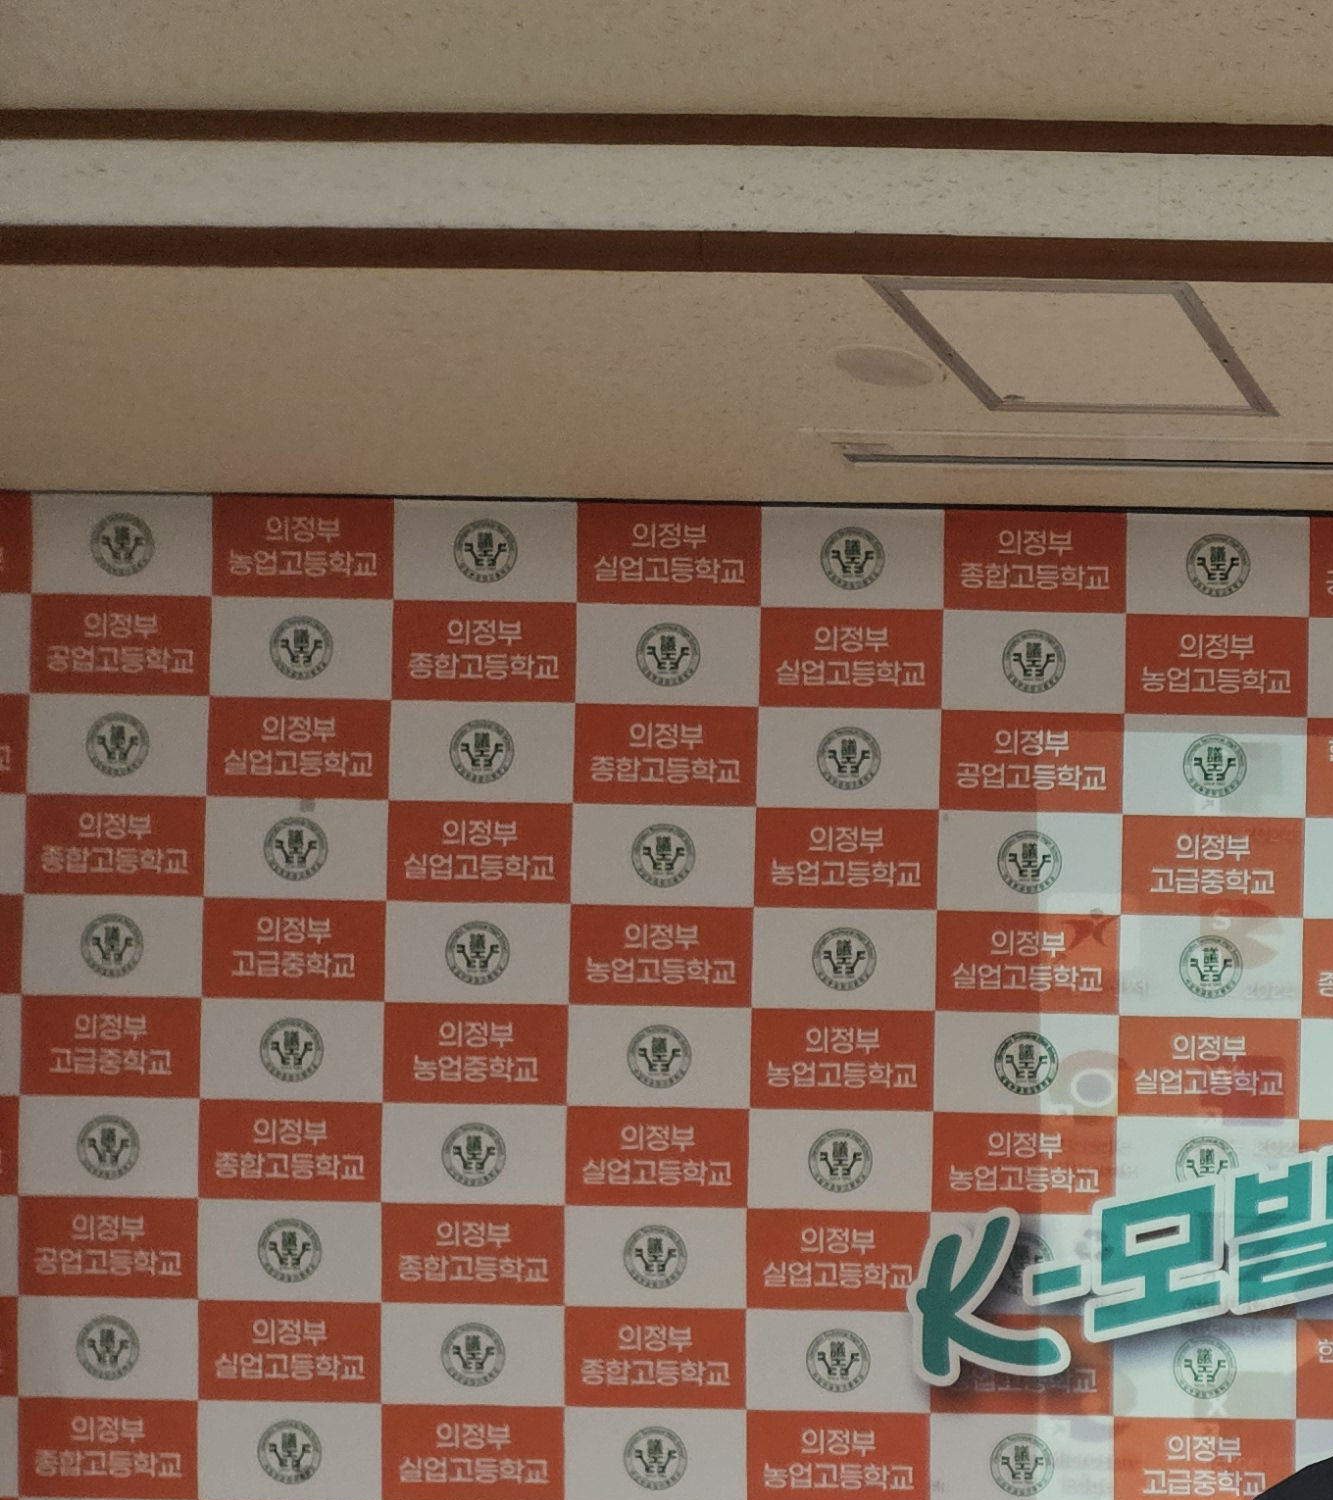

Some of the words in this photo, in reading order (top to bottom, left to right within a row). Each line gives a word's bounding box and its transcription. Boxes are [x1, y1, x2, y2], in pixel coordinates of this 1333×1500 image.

[265, 516, 340, 544] 의정부
[631, 523, 707, 550] 의정부
[997, 529, 1073, 557] 의정부
[959, 561, 1111, 591] 종합고등학교
[1178, 633, 1255, 661] 의정부
[1140, 666, 1292, 695] 농업고등학교
[995, 729, 1070, 758] 의정부
[956, 762, 1108, 792] 공업고등학교
[442, 819, 518, 847] 의정부
[808, 825, 884, 854] 의정부
[1175, 833, 1251, 862] 의정부
[1149, 866, 1276, 895] 고급중학교
[991, 930, 1067, 959] 의정부
[952, 962, 1103, 993] 실업고등학교
[1171, 1033, 1247, 1061] 의정부
[1134, 1068, 1285, 1096] 실업고등학교
[988, 1131, 1063, 1160] 의정부
[949, 1164, 1101, 1195] 농업고등학교
[435, 1221, 512, 1249] 의정부
[801, 1428, 876, 1457] 의정부
